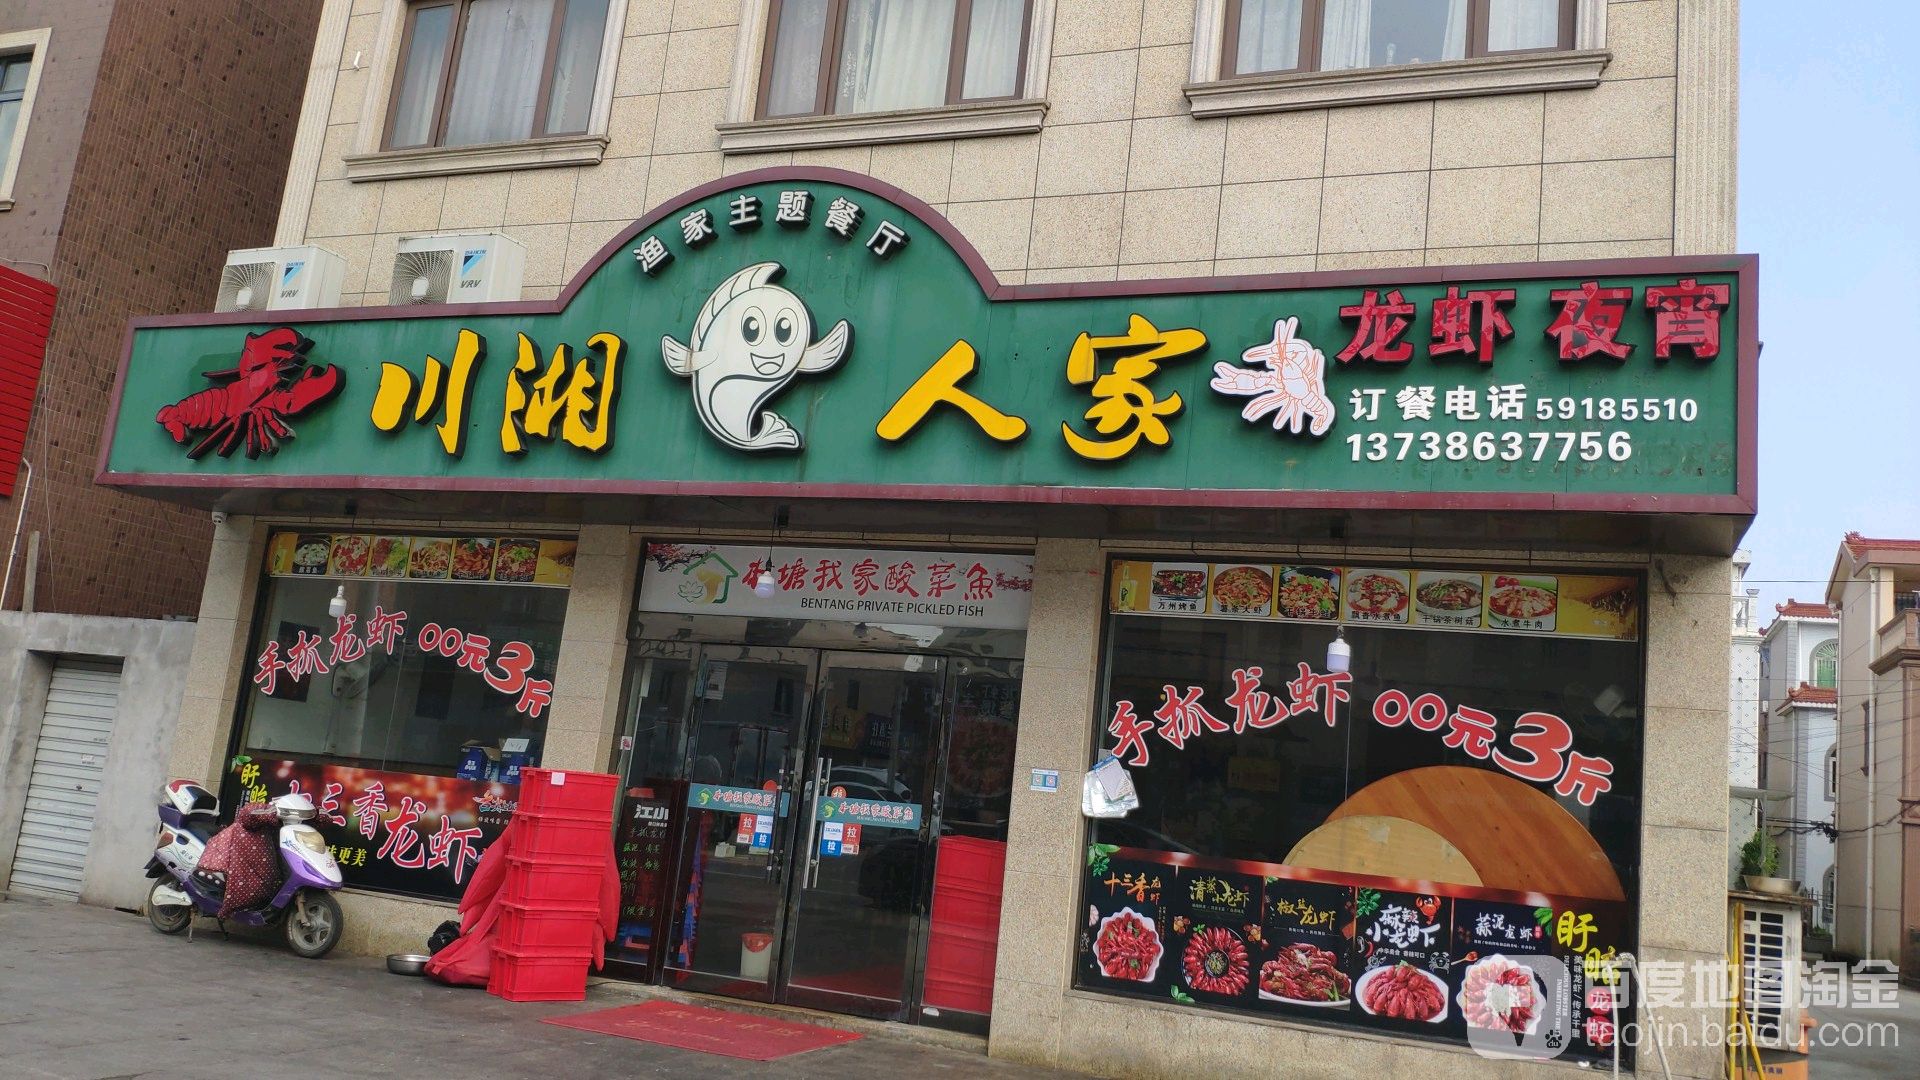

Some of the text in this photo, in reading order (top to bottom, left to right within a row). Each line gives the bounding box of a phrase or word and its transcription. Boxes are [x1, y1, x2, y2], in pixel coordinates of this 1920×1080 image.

[633, 190, 909, 275] 渔家主题餐厅
[460, 279, 481, 288] VRV
[280, 289, 299, 298] VRV
[1336, 279, 1731, 366] 龙虾夜宵
[1348, 384, 1698, 422] 订餐电话 59185510
[1346, 431, 1633, 462] 13738637756
[800, 597, 984, 617] BENTANG PRIVATE PICKLED FISH
[1157, 601, 1197, 612] 万州烤鱼
[1422, 614, 1474, 626] 干锅茶树菇
[1501, 618, 1544, 630] 水煮牛肉
[254, 606, 408, 696] 手抓龙虾
[1107, 661, 1353, 767] 手抓龙虾
[742, 816, 753, 829] 拉
[758, 833, 768, 844] 拉
[847, 826, 858, 839] 拉
[827, 840, 837, 851] 拉
[1475, 911, 1534, 942] 蒜泥龙虾
